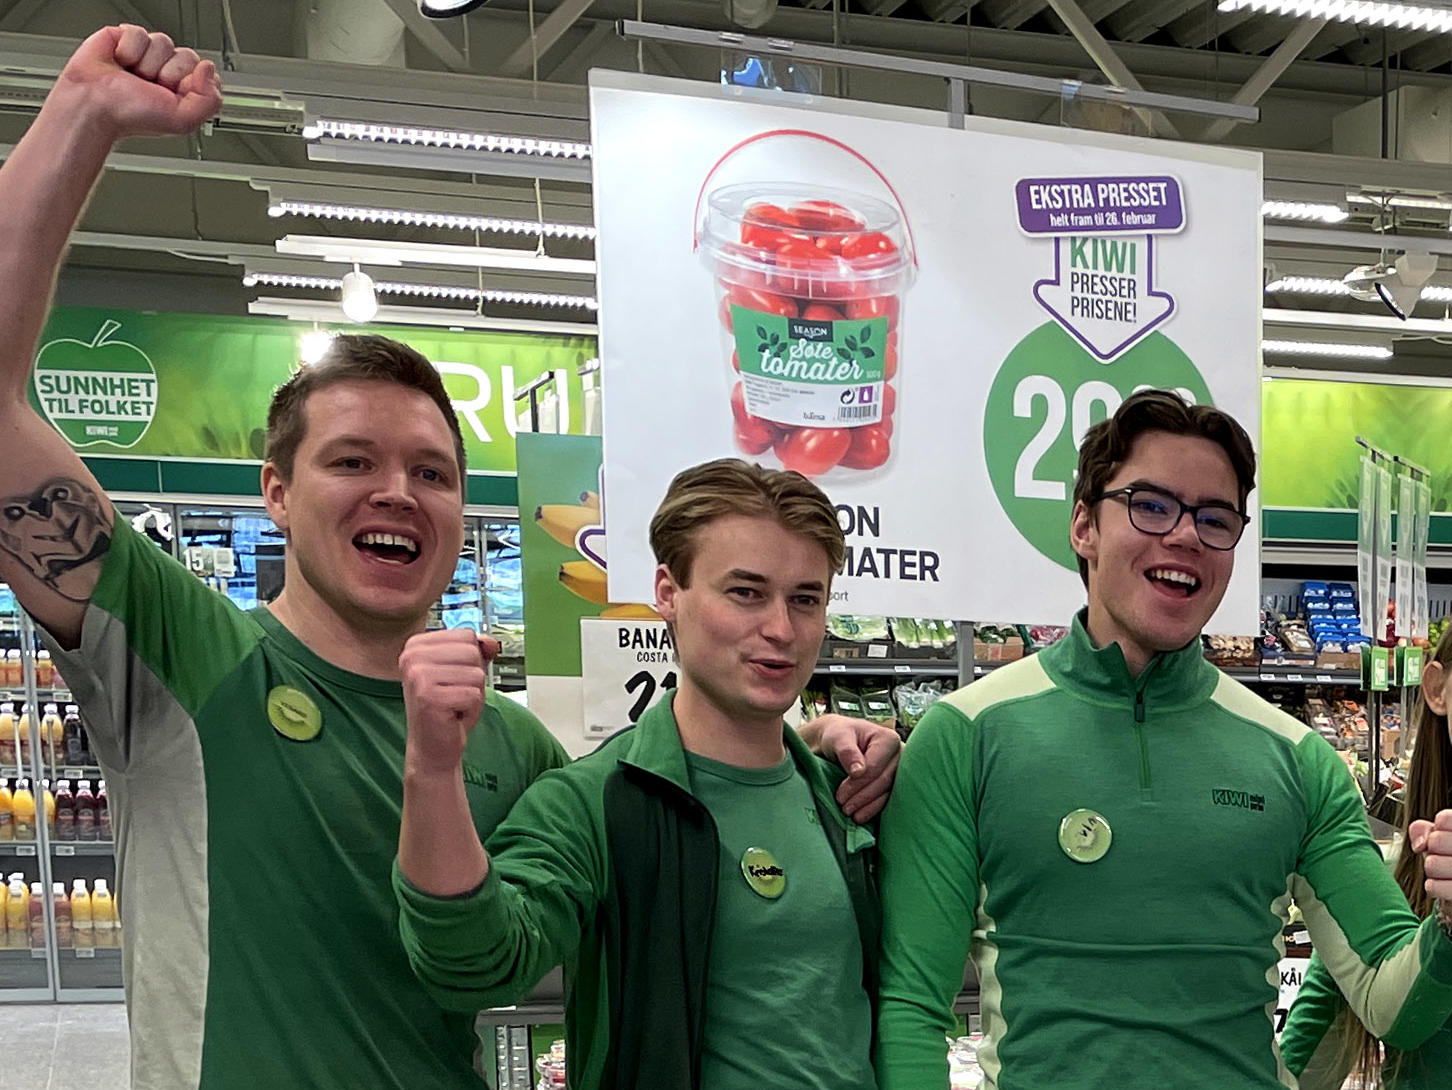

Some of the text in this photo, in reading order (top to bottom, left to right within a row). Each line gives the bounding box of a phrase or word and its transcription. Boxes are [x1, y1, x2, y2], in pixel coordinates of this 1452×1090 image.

[1030, 182, 1168, 210] EKSTRA PRESSET
[1050, 213, 1068, 227] helt
[1071, 213, 1093, 226] fram
[1094, 212, 1104, 225] til
[1122, 211, 1156, 225] februar
[1070, 236, 1136, 275] KIWI
[1070, 272, 1136, 299] PRESSER
[1071, 296, 1137, 323] PRISENE!
[794, 325, 828, 338] SEASON
[761, 349, 864, 381] tomater
[40, 374, 155, 397] SUNNHET
[44, 398, 154, 416] TIL FOLKET
[637, 652, 669, 663] COSTA
[1212, 789, 1249, 808] KIWI
